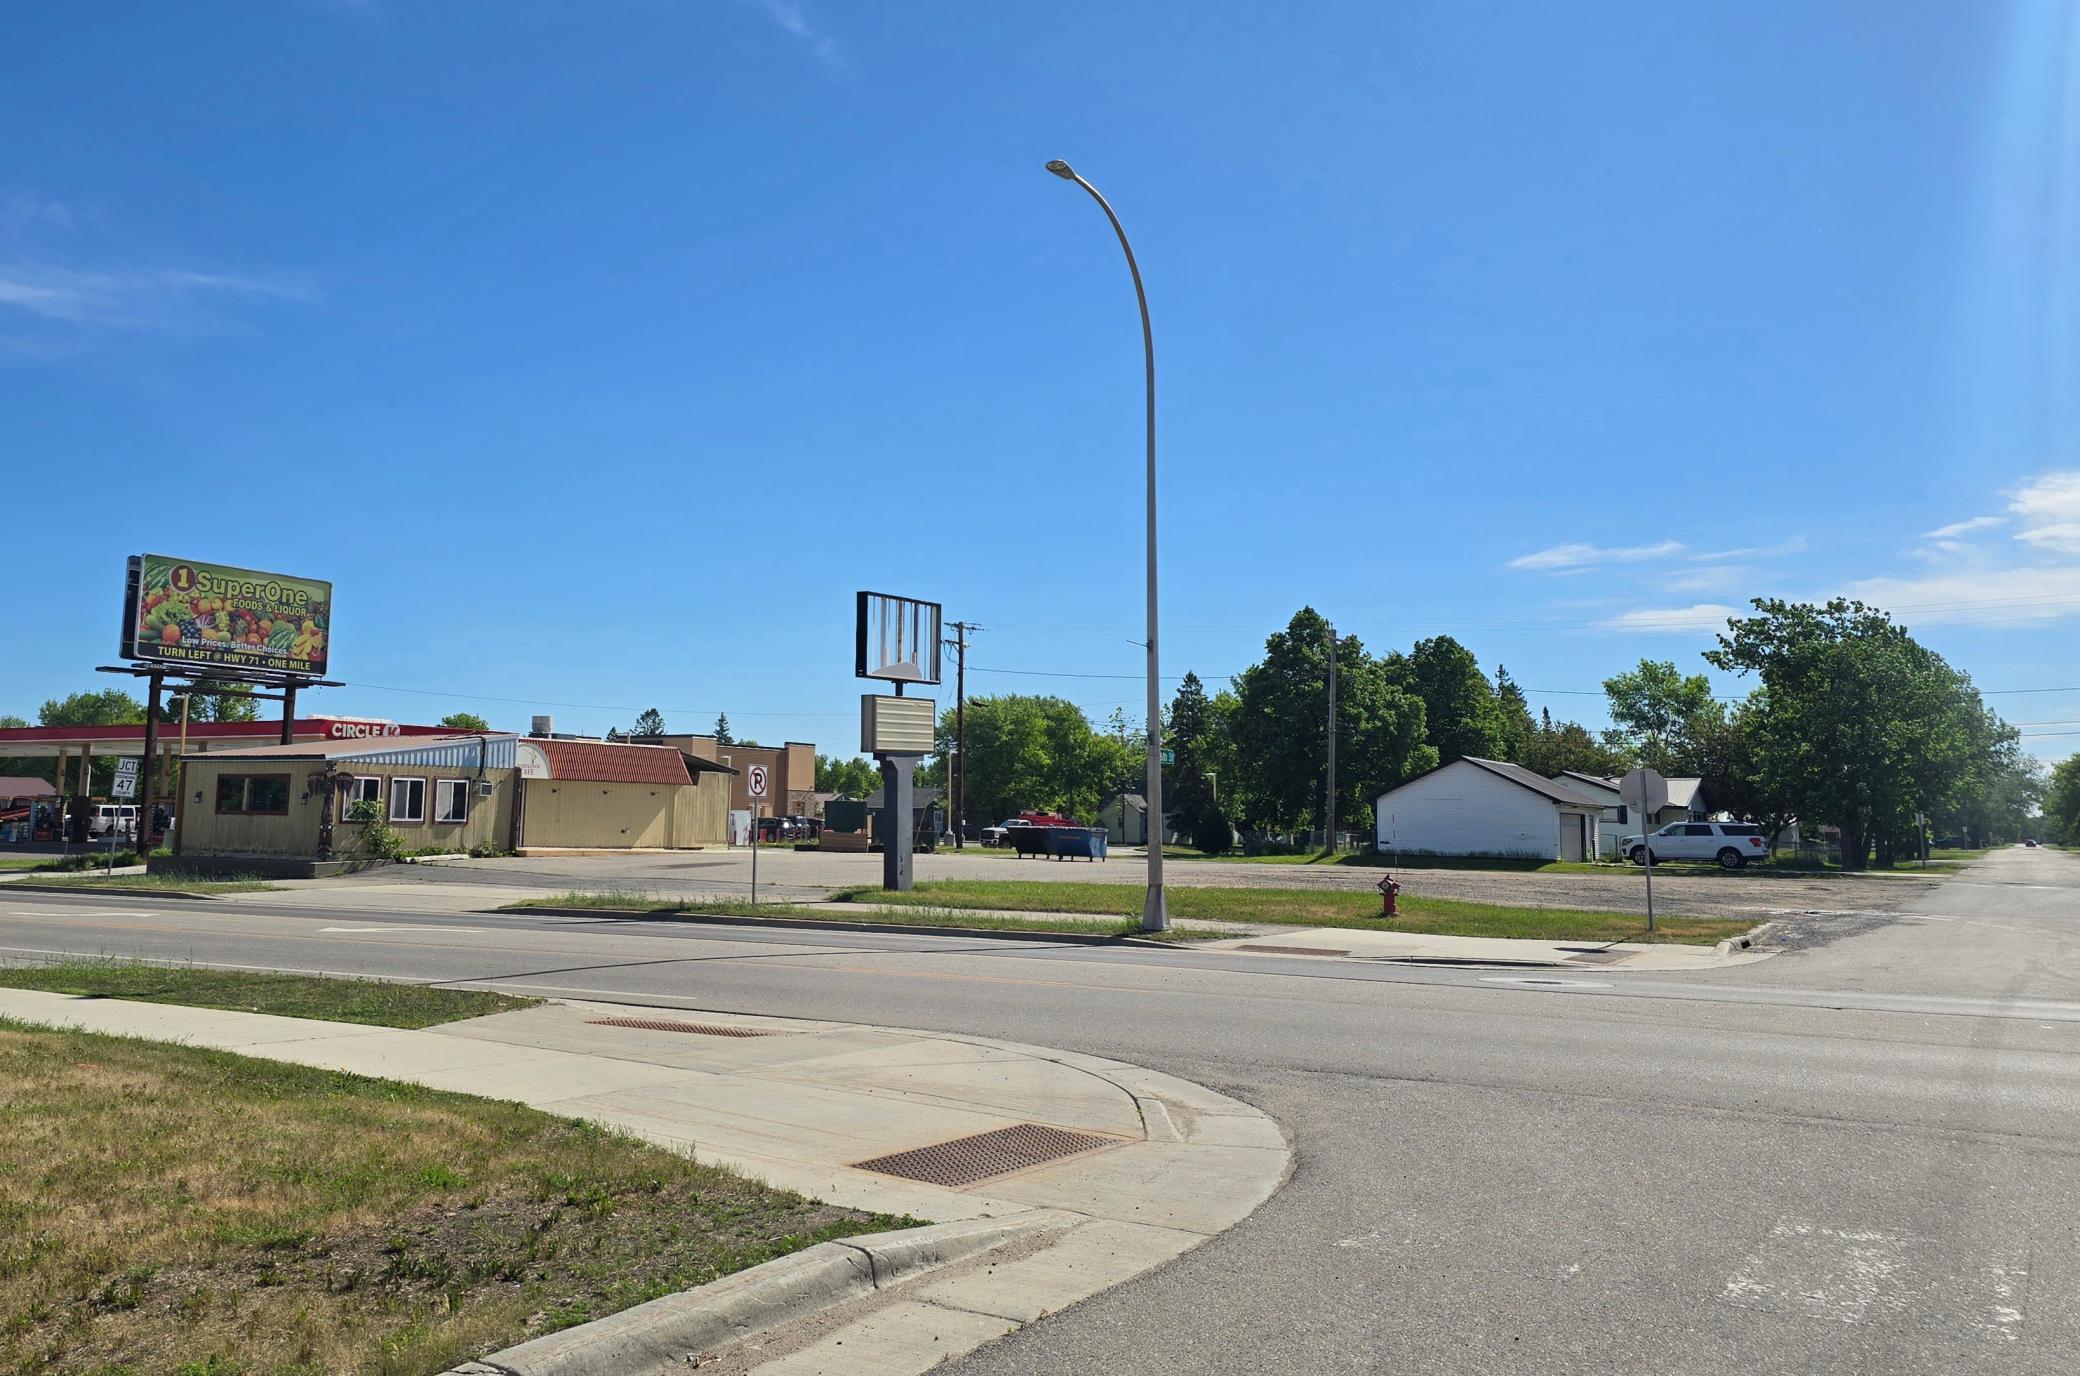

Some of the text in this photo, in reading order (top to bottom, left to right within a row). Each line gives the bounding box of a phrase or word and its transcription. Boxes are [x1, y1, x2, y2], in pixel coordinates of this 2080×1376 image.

[177, 568, 308, 606] 1 SuperOne
[233, 598, 307, 617] FOODS & LIQUOR
[182, 636, 200, 645] Low
[158, 646, 311, 671] TURN LEFT @ HWY 71 ONE MILE
[332, 723, 381, 738] CIRCLE
[119, 760, 136, 771] JCT
[116, 780, 133, 790] 47
